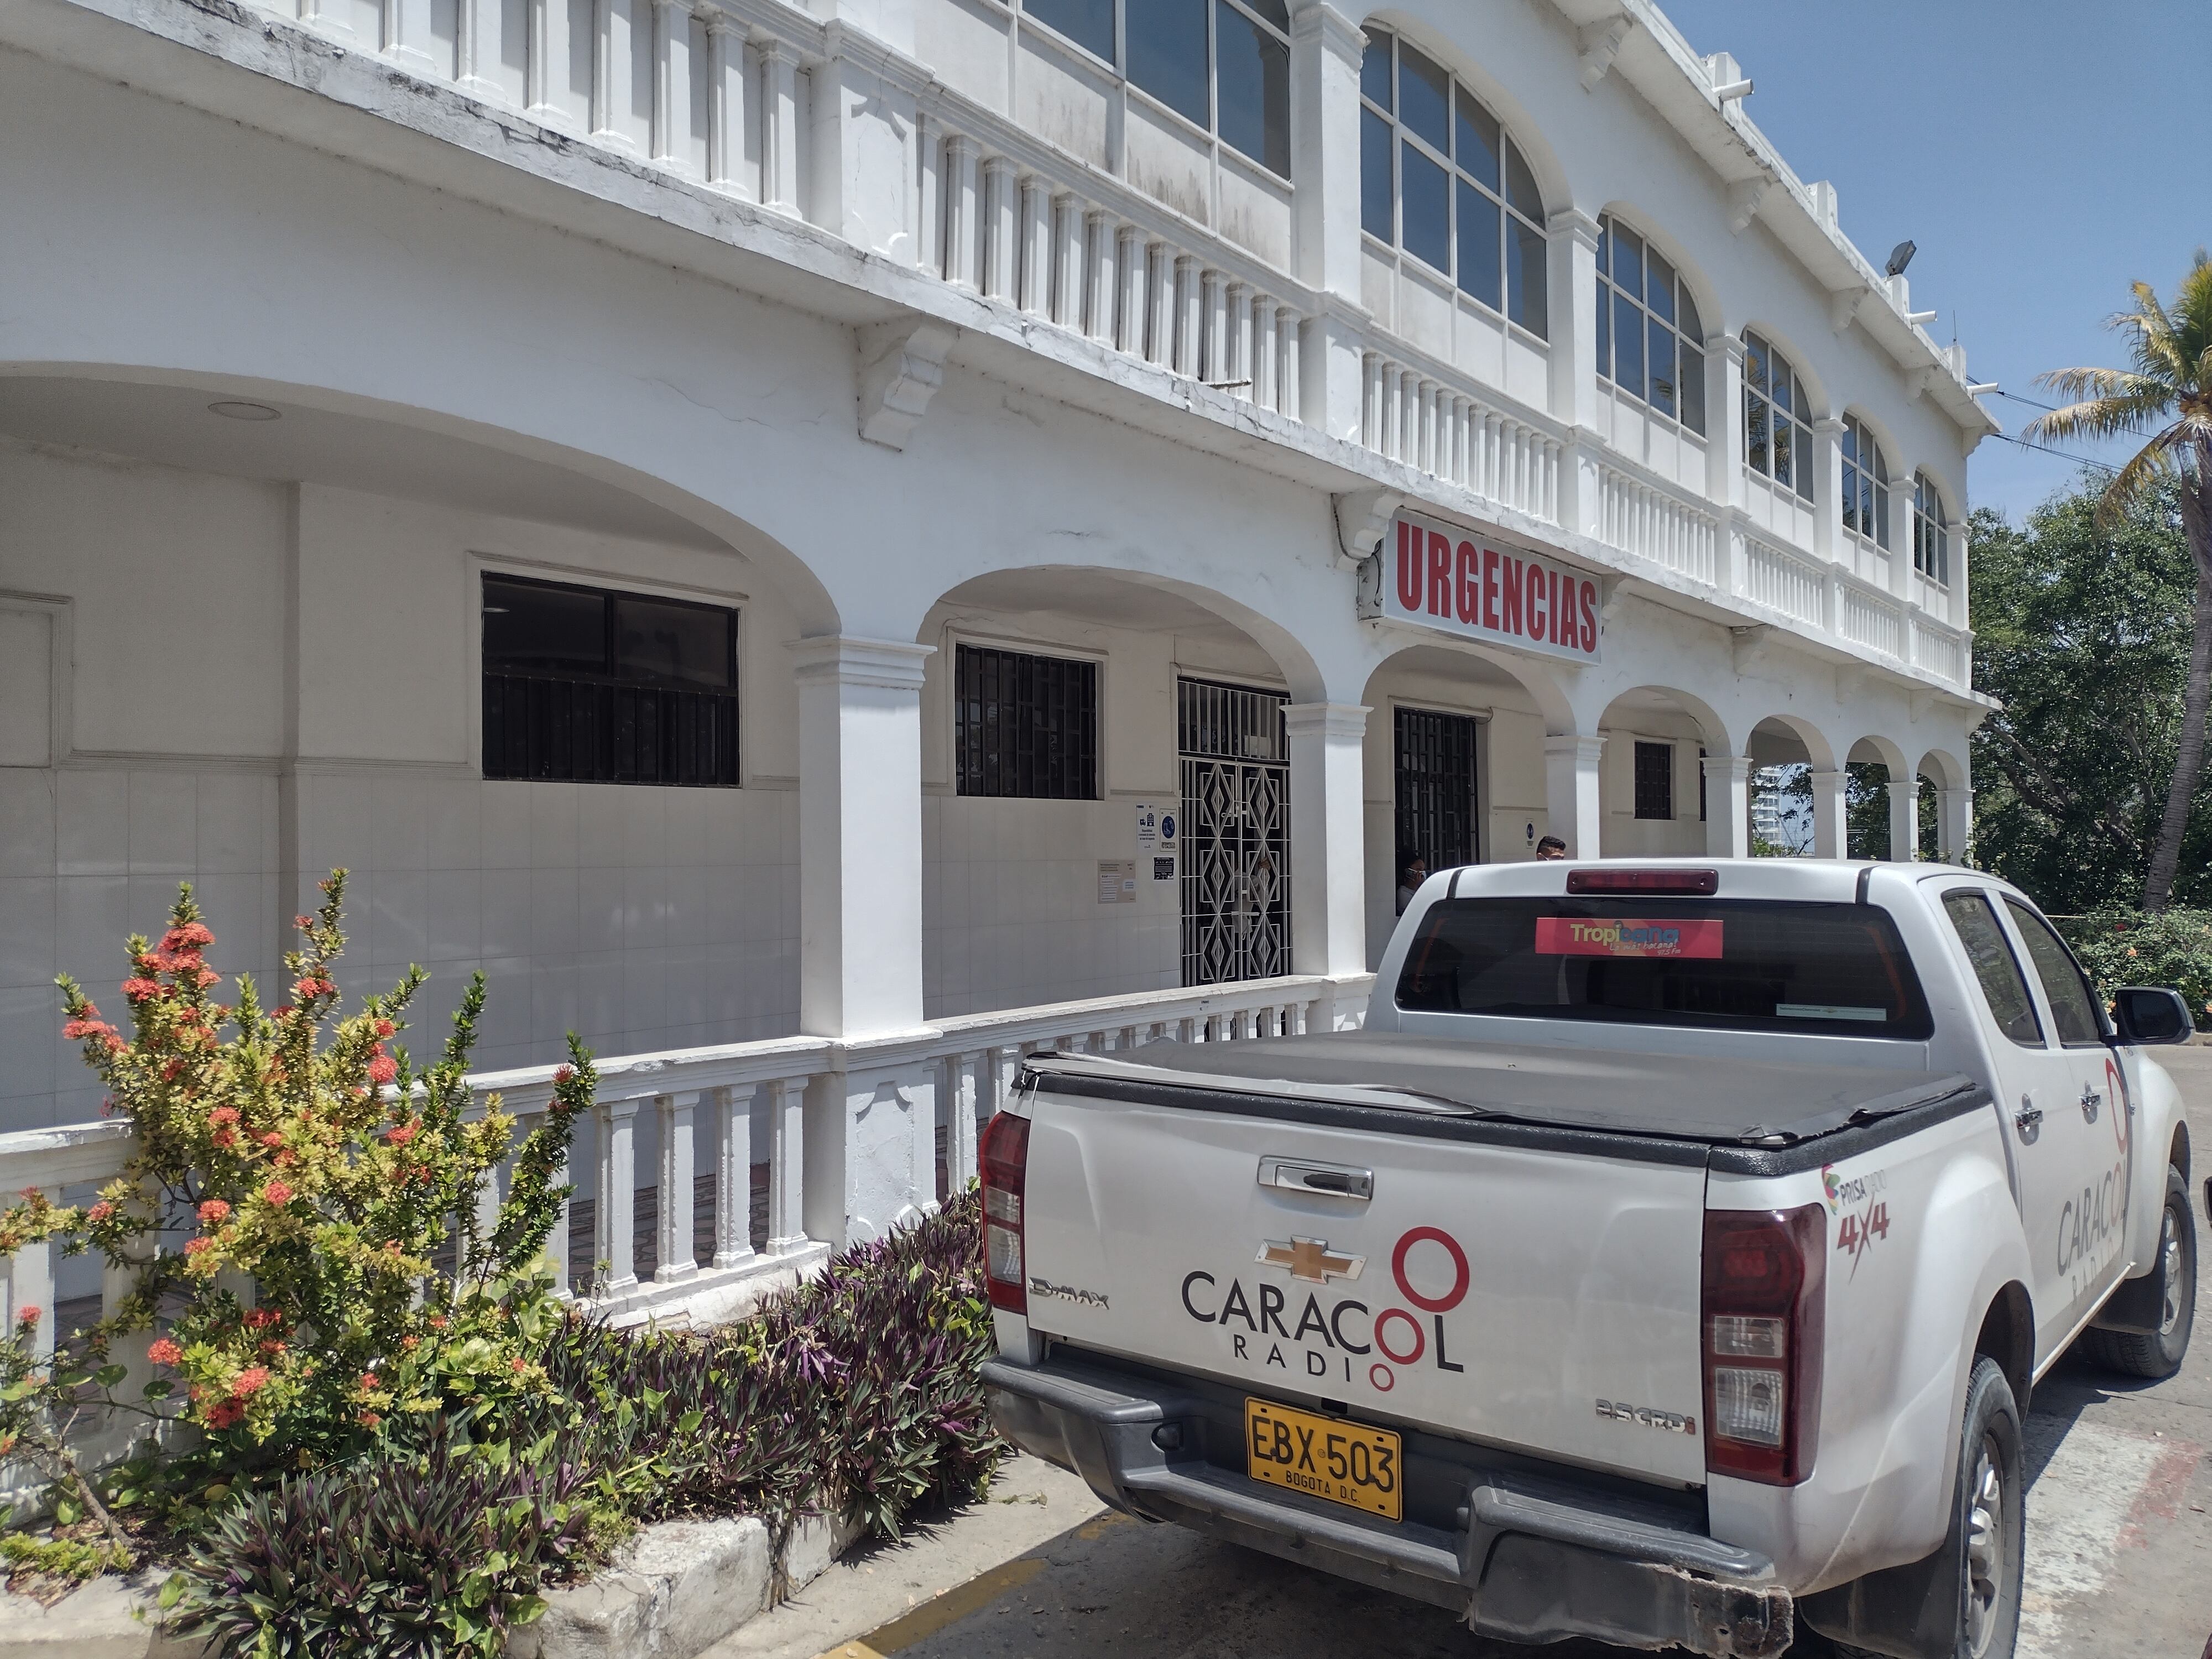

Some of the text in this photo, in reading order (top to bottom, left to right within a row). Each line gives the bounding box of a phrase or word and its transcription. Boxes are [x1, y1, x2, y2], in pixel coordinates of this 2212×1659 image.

[1397, 520, 1597, 653] URGENCIAS
[1570, 920, 1680, 946] Tropicana
[2058, 1159, 2126, 1277] CARACOL
[1029, 1277, 1110, 1310] D-MAX
[1182, 1270, 1464, 1374] CARACOL
[1234, 1334, 1395, 1392] RADIO
[1251, 1415, 1394, 1493] EBX 503
[1286, 1470, 1361, 1503] BOGOTA D.C.
